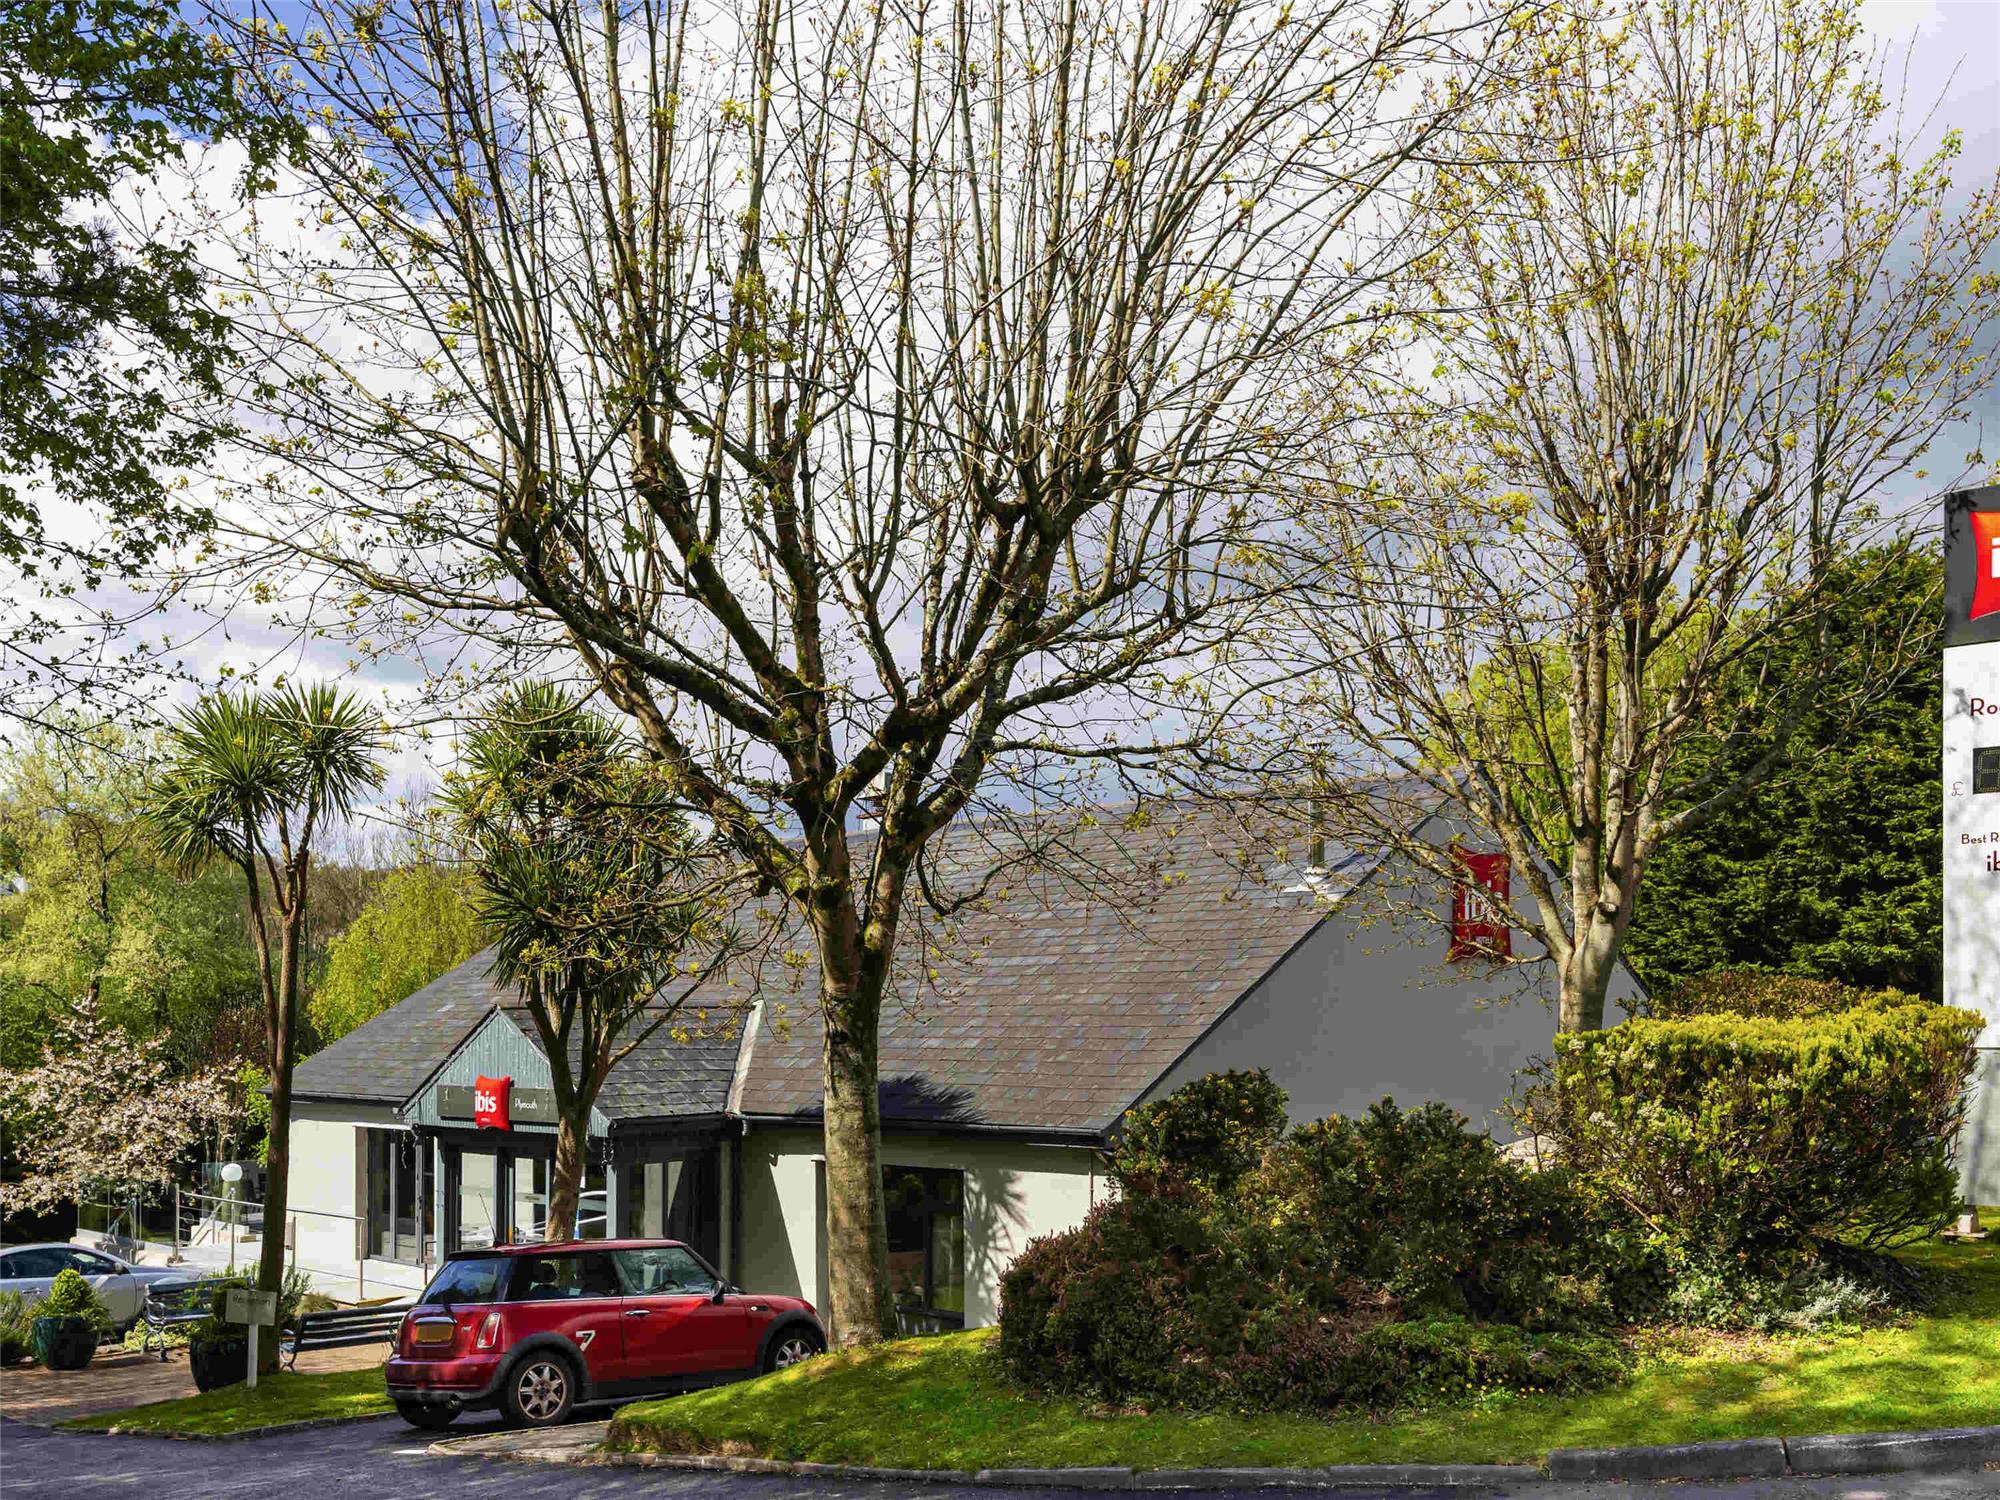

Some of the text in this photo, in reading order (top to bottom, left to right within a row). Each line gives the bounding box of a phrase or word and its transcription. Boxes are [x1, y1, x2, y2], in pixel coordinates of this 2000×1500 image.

[1970, 698, 2000, 716] Ro
[1961, 832, 2000, 845] Best R
[475, 1091, 496, 1113] ibis
[515, 1098, 538, 1111] Plymouth
[576, 1330, 596, 1351] 7
